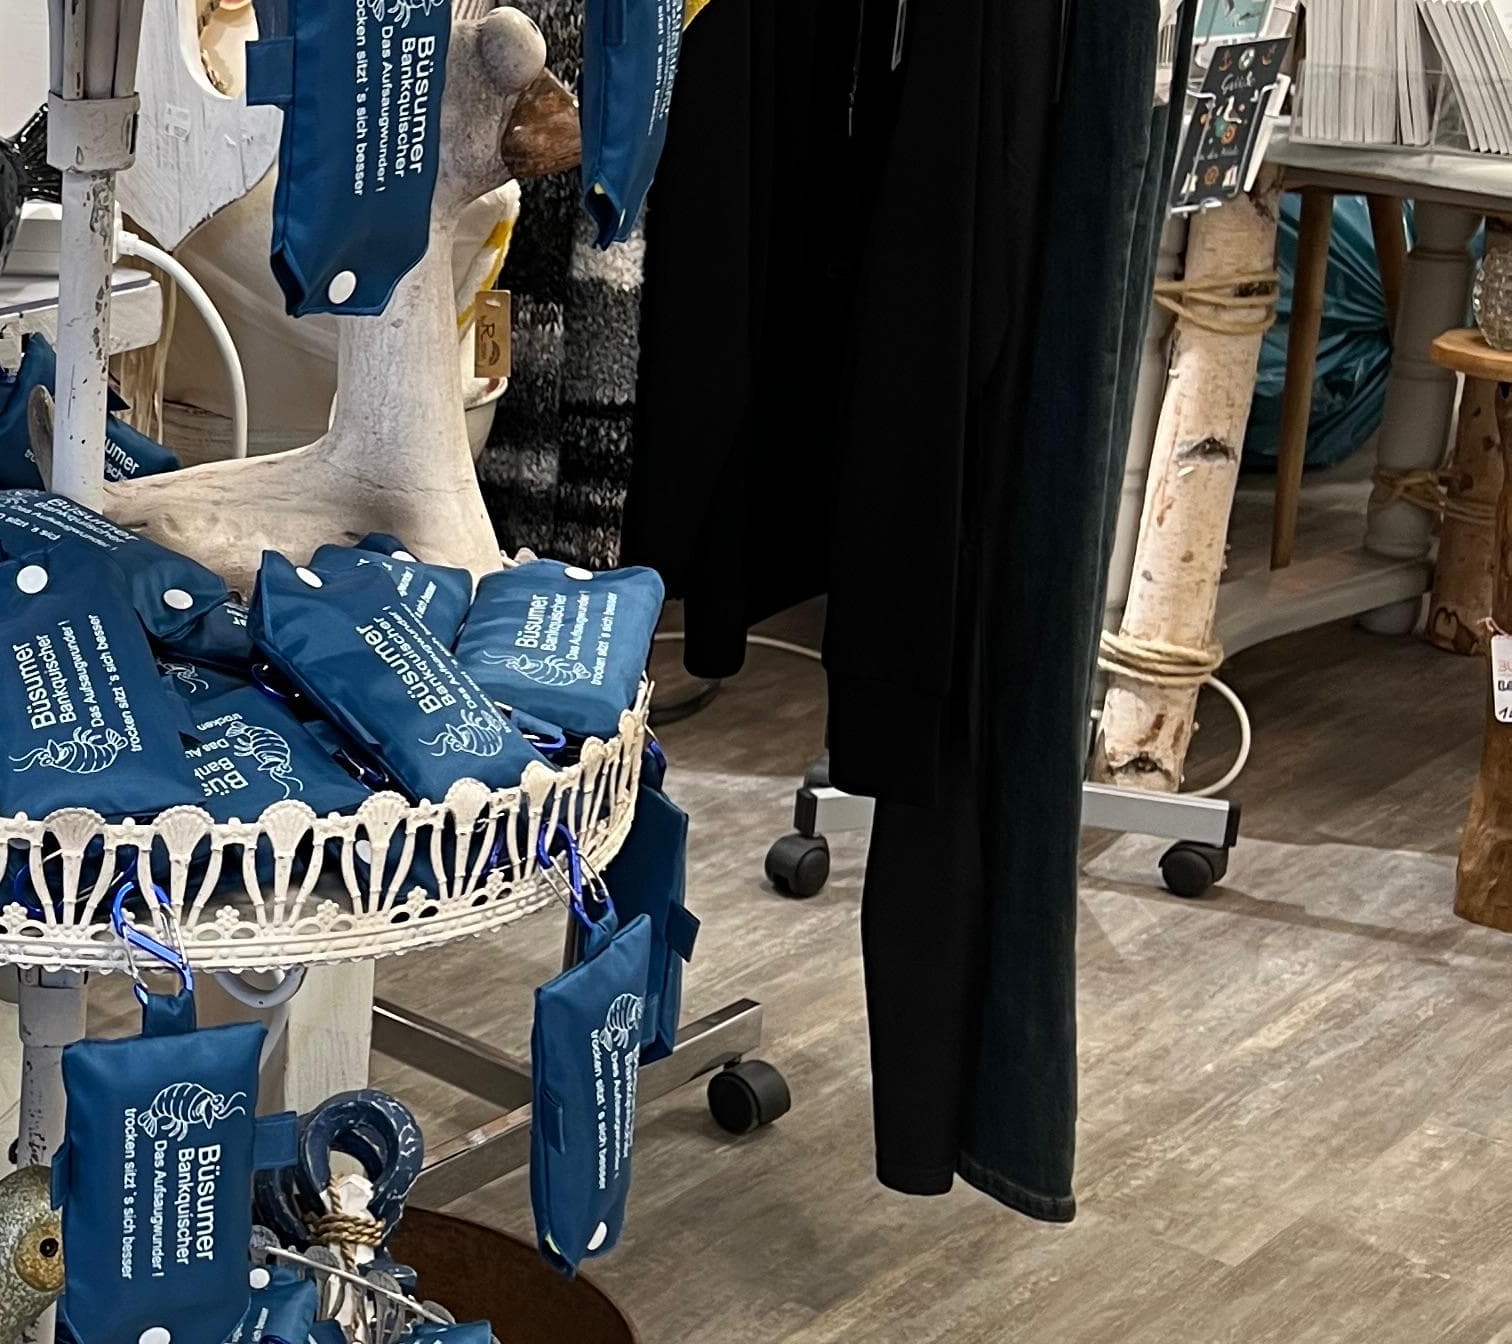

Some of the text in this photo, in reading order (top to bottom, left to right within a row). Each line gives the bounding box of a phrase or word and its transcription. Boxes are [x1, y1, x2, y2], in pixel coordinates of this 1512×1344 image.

[356, 51, 368, 84] sitzt
[377, 26, 393, 183] Das Aufsaugwunder
[395, 38, 416, 178] Bankquischer
[410, 36, 436, 174] Büsumer
[354, 142, 367, 196] besser
[357, 108, 368, 140] sich
[47, 498, 139, 541] Büsumer
[373, 616, 457, 708] Bankquischer
[514, 594, 550, 650] Büsumer
[540, 592, 568, 652] Bankquischer
[565, 643, 580, 661] Das
[13, 642, 57, 730] Büsumer
[36, 634, 77, 724] Bankquischer
[62, 625, 105, 728] Das Aufsaugwunder
[88, 614, 143, 753] trocken sitzt sich besser
[355, 624, 443, 715] Büsumer
[458, 687, 478, 711] Das
[196, 712, 244, 732] trocken
[200, 738, 230, 752] Das
[121, 1108, 137, 1280] trocken sitzt sich besser
[150, 1140, 168, 1269] Das Aufsaugwunder
[174, 1148, 195, 1265] Bankquischer
[196, 1144, 221, 1261] Büsumer
